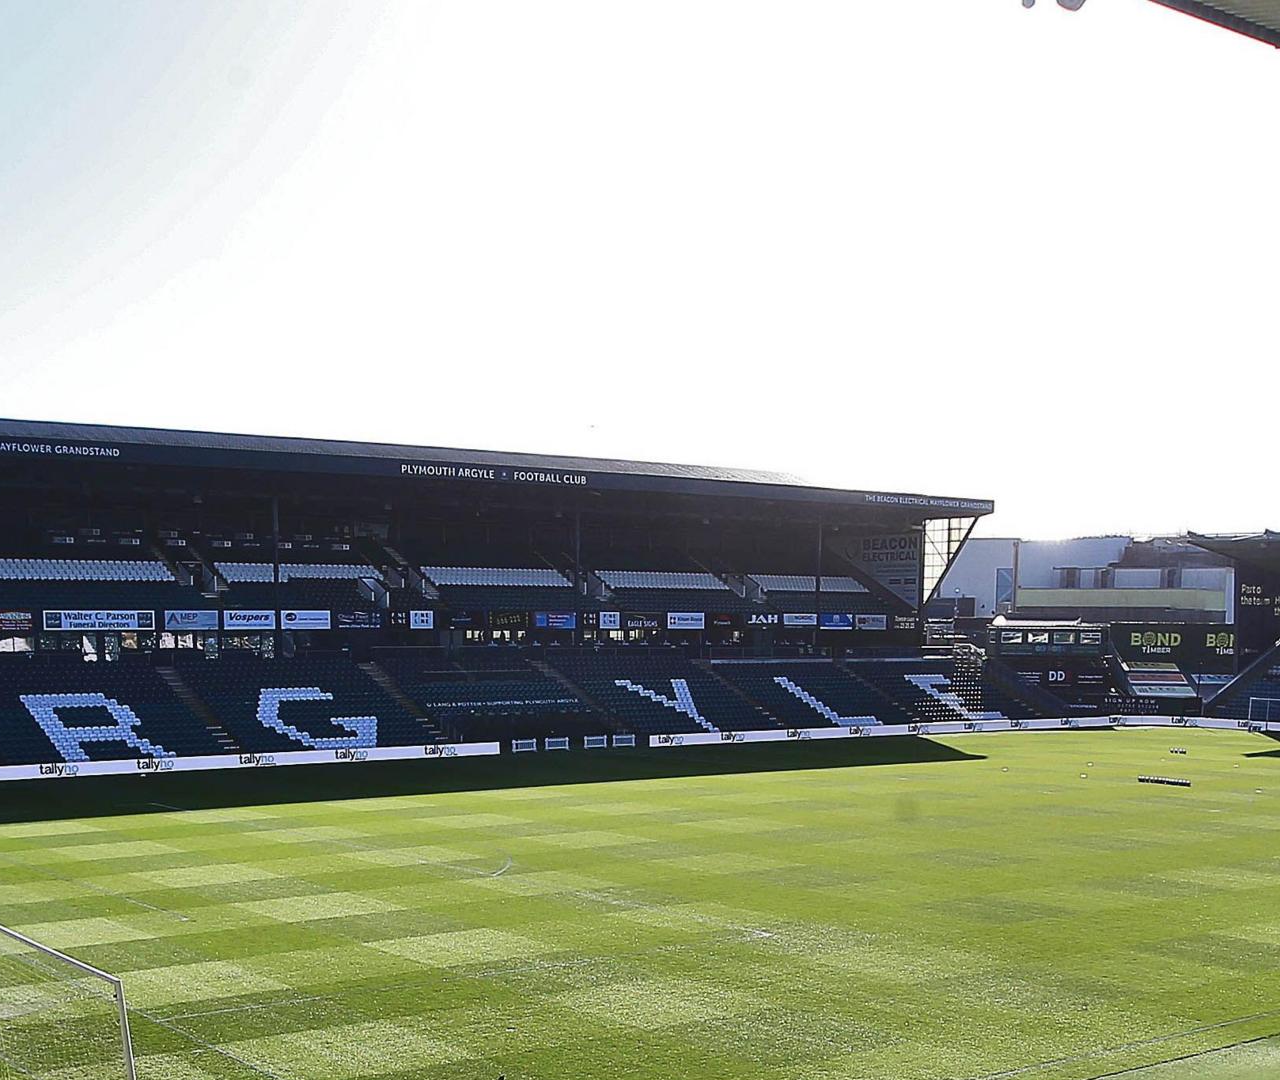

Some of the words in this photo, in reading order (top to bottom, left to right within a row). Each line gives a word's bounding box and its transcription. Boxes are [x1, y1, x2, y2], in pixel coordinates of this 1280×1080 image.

[55, 445, 120, 457] GRANDSTAND
[400, 464, 456, 477] PLYMOUTH
[457, 467, 495, 479] ARGYLE
[513, 471, 562, 484] FOOTBALL
[563, 475, 588, 486] CLUB
[863, 537, 918, 551] BEACON
[863, 551, 917, 562] ELECTRICAL
[63, 612, 92, 621] Walter
[106, 612, 136, 621] Parson
[228, 612, 270, 623] Vospers
[747, 614, 779, 624] JAH
[69, 621, 96, 629] Funeral
[98, 621, 130, 629] Directors
[1130, 631, 1182, 647] BOND
[1205, 632, 1235, 647] BO
[1141, 644, 1171, 654] TIMBER
[786, 729, 811, 739] tallyho
[658, 735, 684, 746] tallyho
[335, 749, 368, 760] tallyho
[424, 744, 456, 756] tallyho
[136, 758, 174, 771] tallyho
[239, 753, 275, 765] tallyho
[39, 763, 79, 776] tallyho
